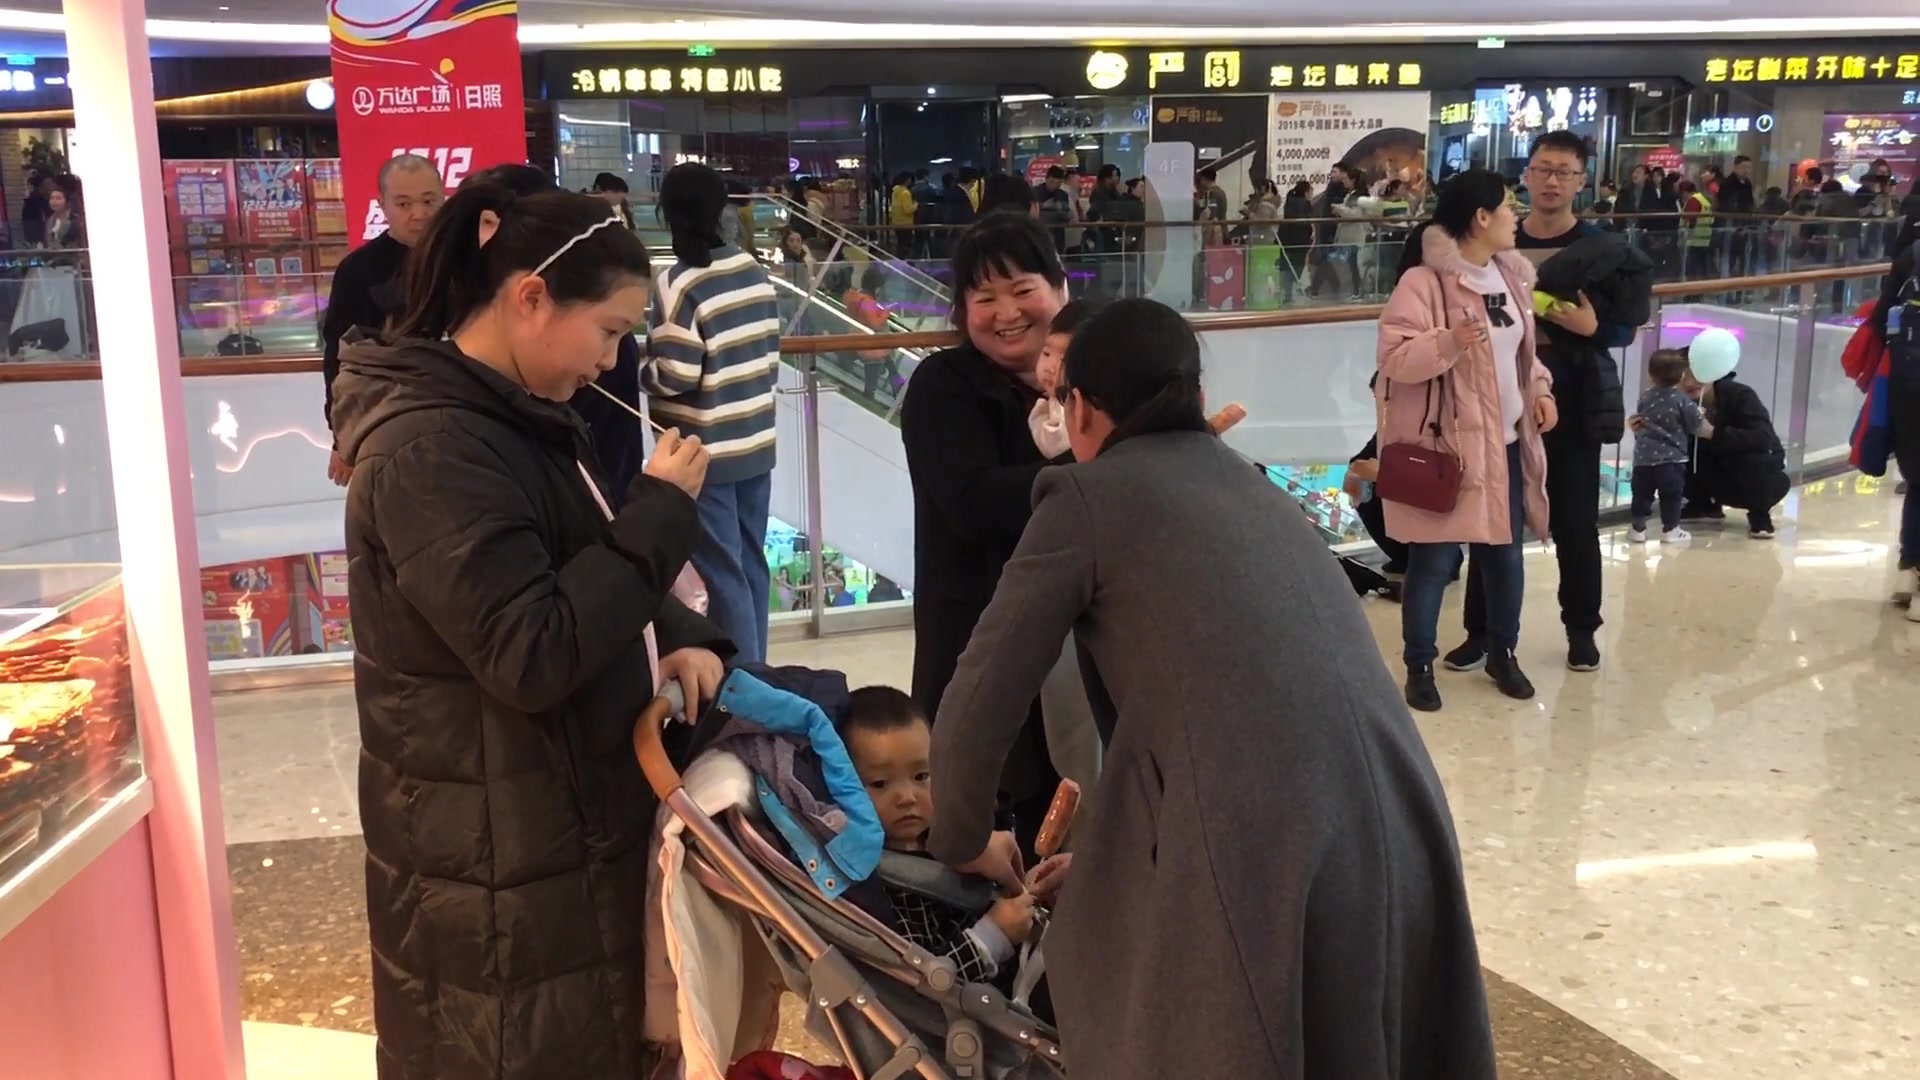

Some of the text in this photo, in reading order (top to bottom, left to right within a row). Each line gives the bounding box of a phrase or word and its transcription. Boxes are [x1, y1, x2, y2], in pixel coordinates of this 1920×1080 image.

[572, 67, 782, 92] 冷锅串串 特色小吃
[1270, 62, 1421, 87] 老坛酸菜鱼
[1706, 54, 1920, 81] 老坛酸菜 开味十足
[377, 84, 503, 109] 万达广场 日照
[378, 105, 451, 114] WANDA PLAZA
[1276, 147, 1331, 161] 4,000,000份
[1158, 159, 1181, 175] 4F
